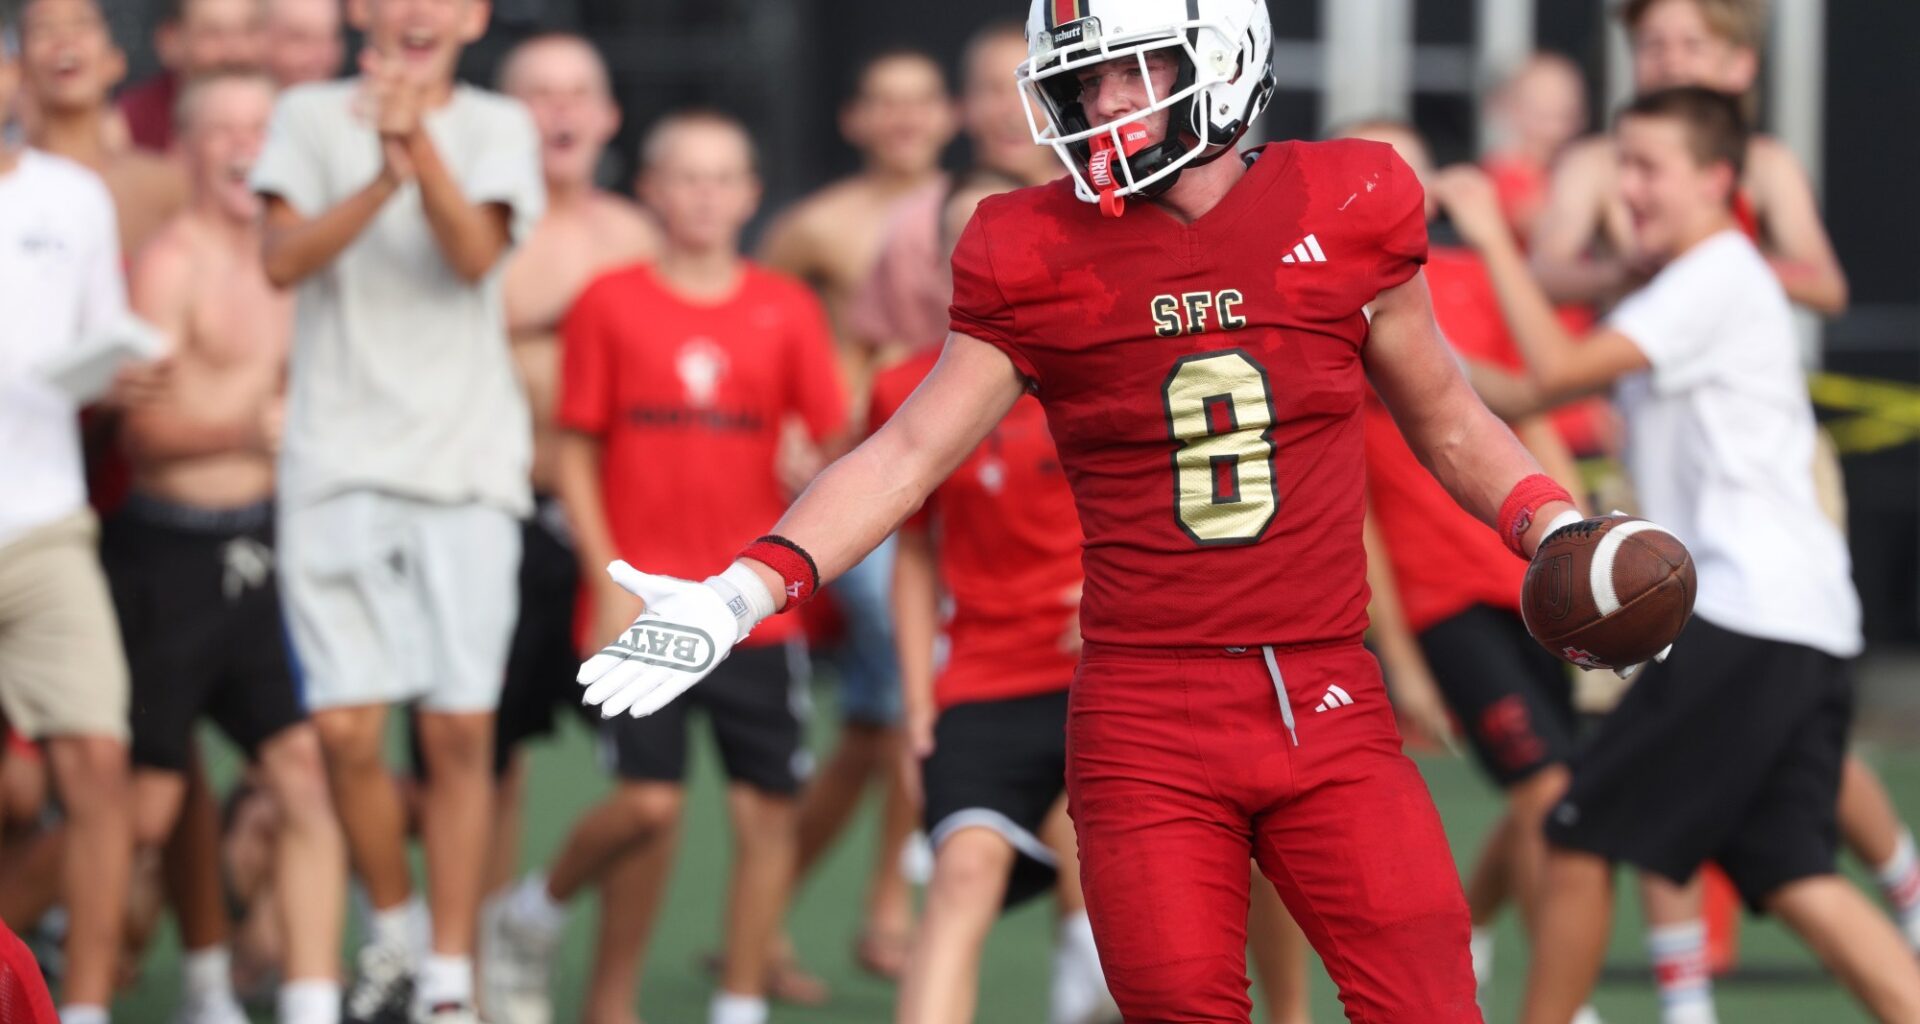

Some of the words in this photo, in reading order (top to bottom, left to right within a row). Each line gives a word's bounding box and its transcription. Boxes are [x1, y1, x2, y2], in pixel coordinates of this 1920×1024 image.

[1054, 26, 1081, 42] schutt
[1150, 288, 1246, 338] SFC
[1161, 348, 1279, 546] 8
